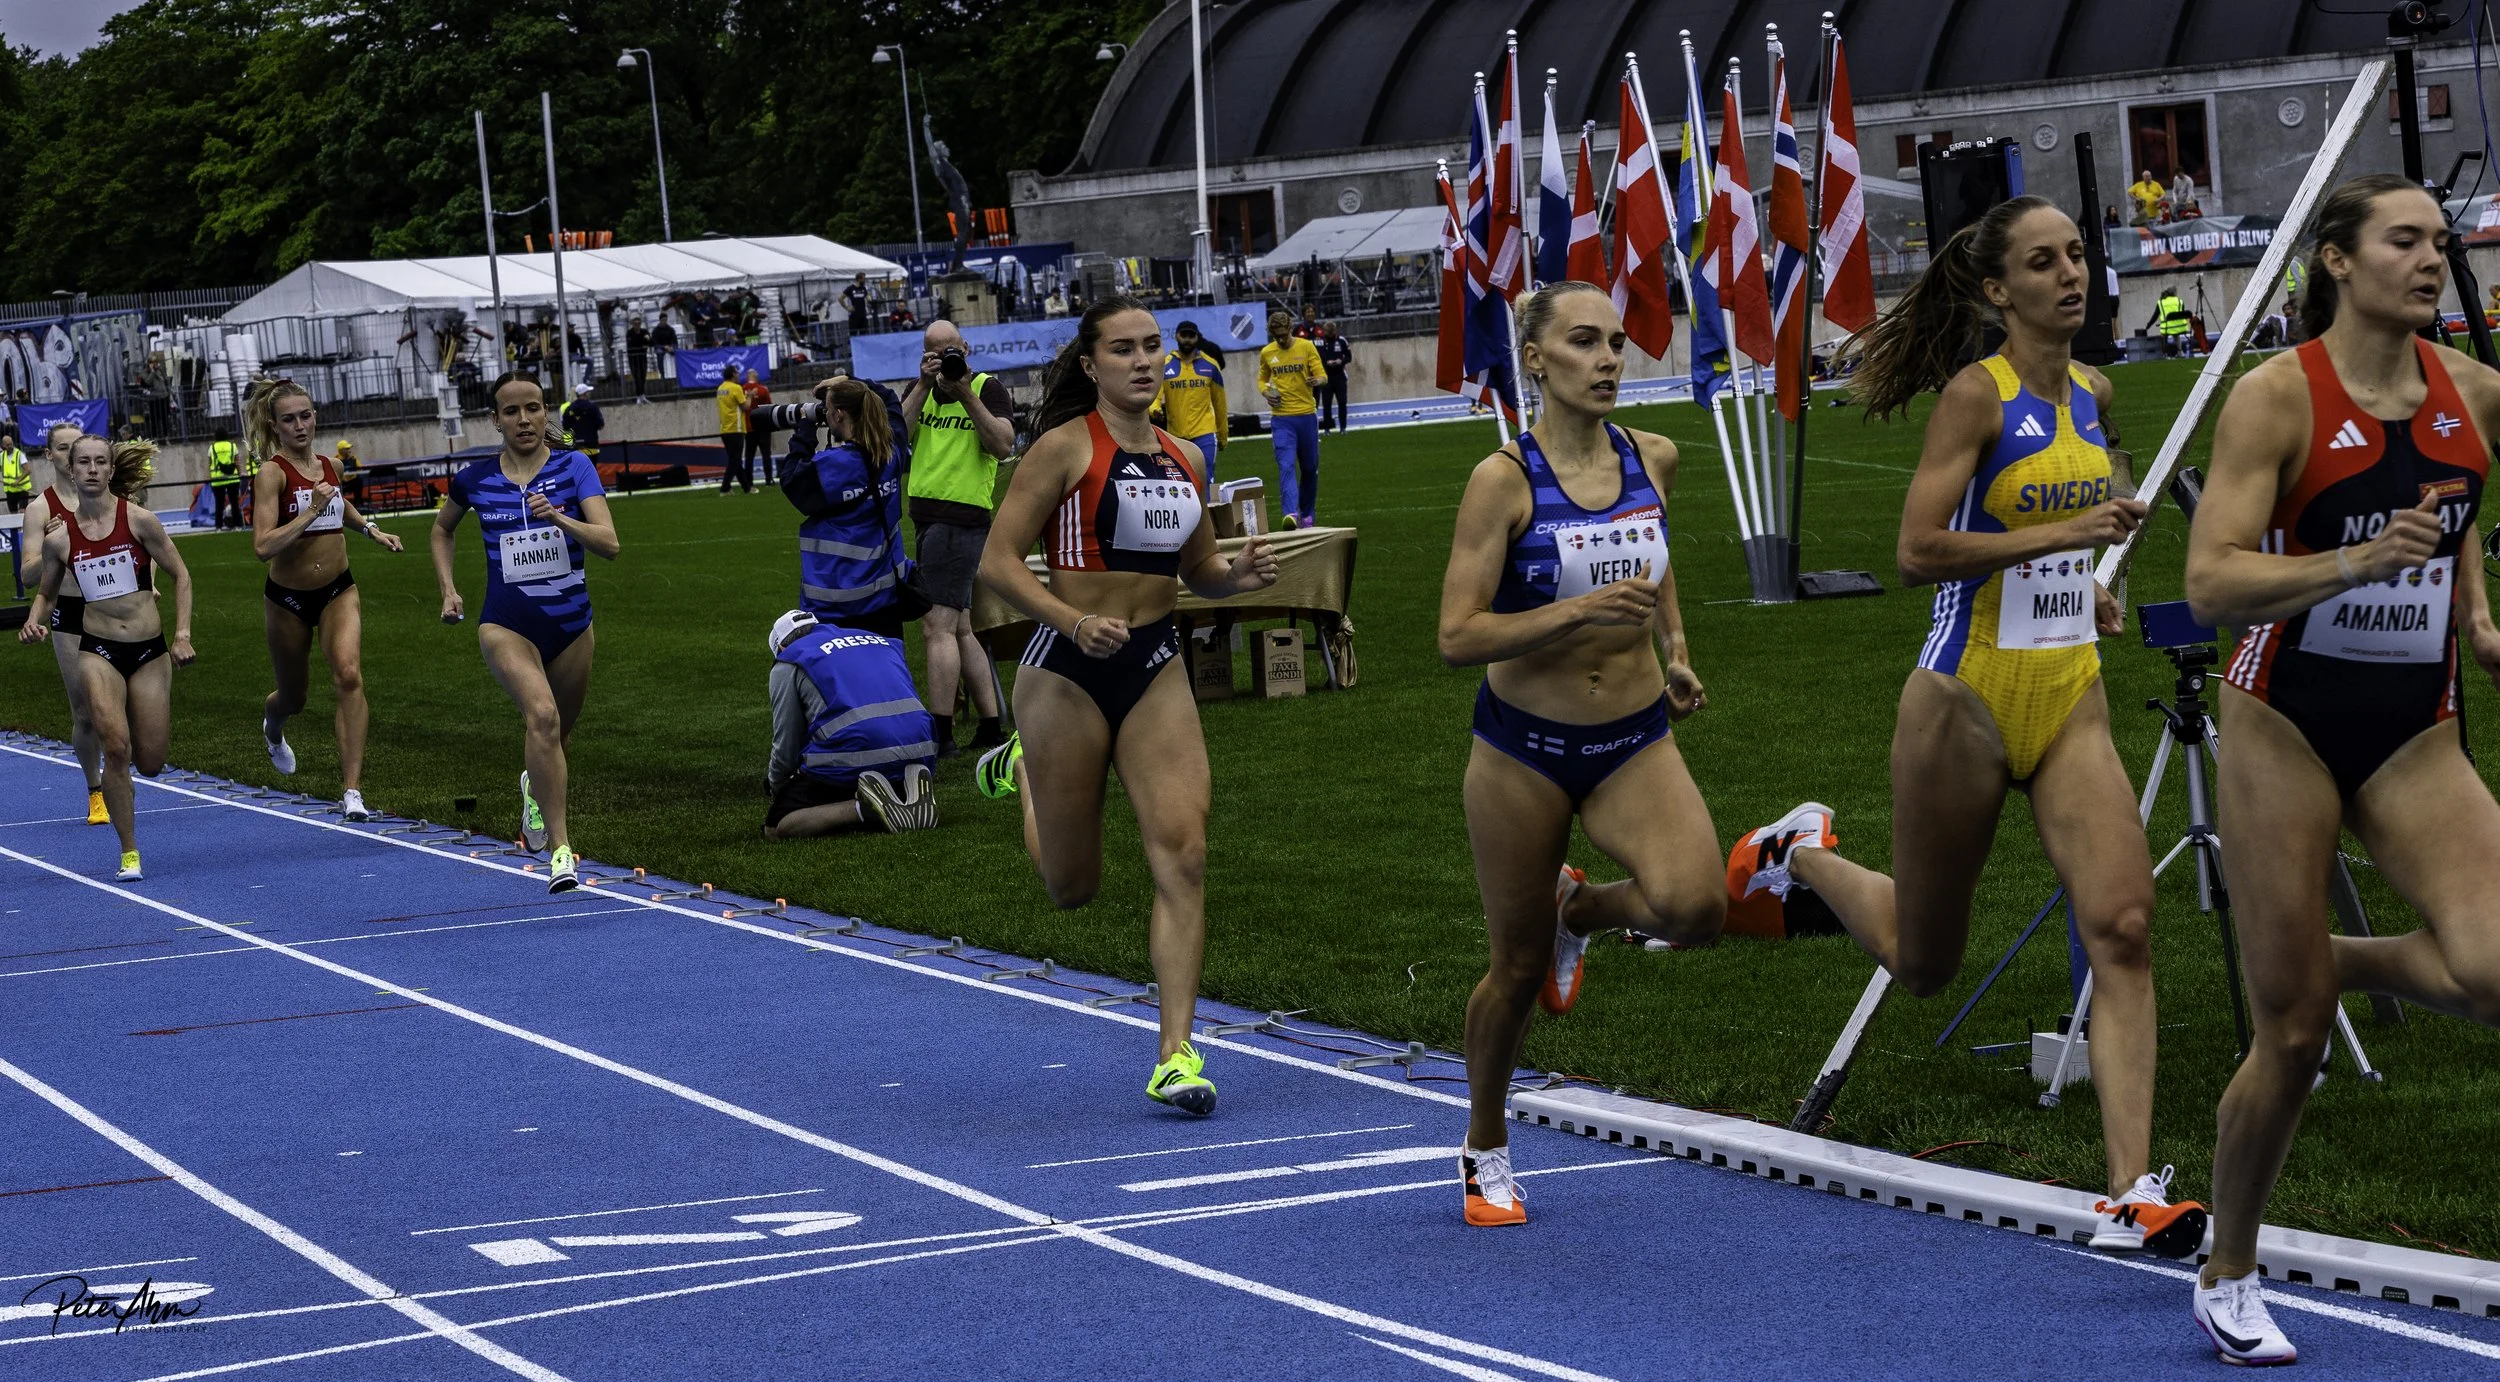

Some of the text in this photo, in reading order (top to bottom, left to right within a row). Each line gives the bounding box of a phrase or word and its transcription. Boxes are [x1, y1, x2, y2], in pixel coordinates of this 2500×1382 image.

[2141, 239, 2167, 257] BLIV
[2170, 237, 2193, 253] VED
[2194, 232, 2219, 251] MED
[2222, 230, 2236, 248] AT
[2239, 229, 2271, 247] BLIVE
[702, 361, 725, 371] Dansk
[1272, 364, 1305, 376] SWEDEN
[483, 513, 507, 521] CRAFT
[1145, 509, 1180, 529] NORA
[2341, 503, 2471, 543] NOAY
[513, 546, 559, 567] HANNAH
[97, 573, 116, 587] MIA
[1590, 557, 1642, 586] VEERA
[284, 596, 301, 610] DEN
[2033, 590, 2083, 620] MARIA
[2332, 603, 2428, 631] AMANDA
[95, 645, 112, 660] DEN
[820, 635, 890, 655] PRESSE
[1268, 670, 1303, 681] KONDI
[1271, 662, 1299, 672] FAXE
[1581, 736, 1633, 755] CRAFT
